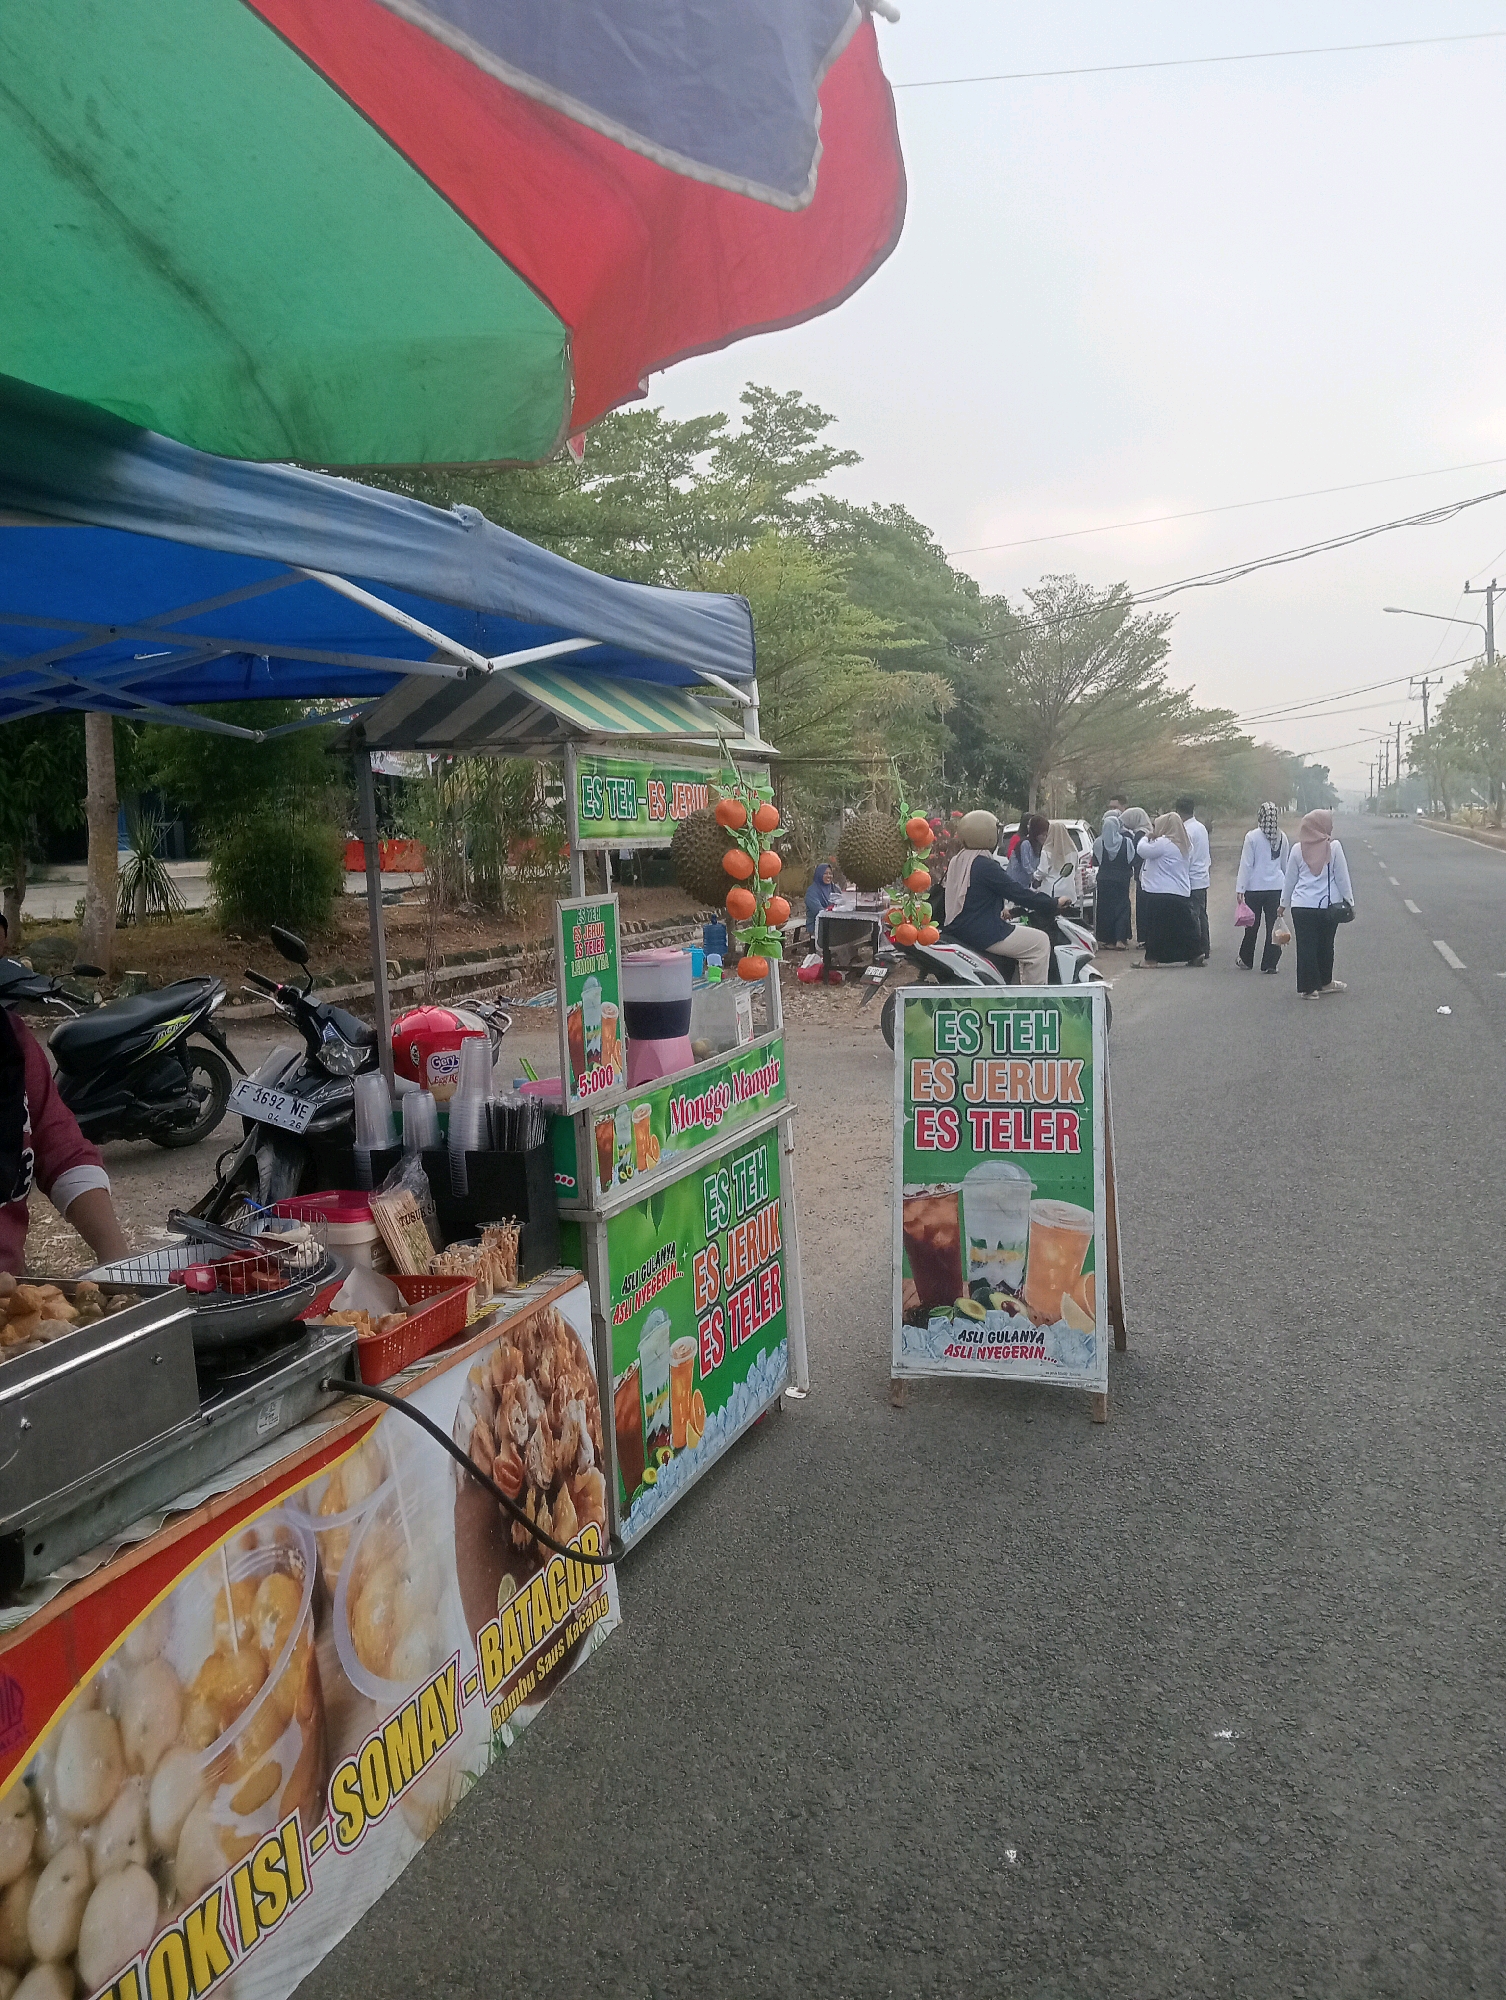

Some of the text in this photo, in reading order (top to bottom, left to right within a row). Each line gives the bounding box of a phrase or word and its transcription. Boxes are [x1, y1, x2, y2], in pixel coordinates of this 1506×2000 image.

[582, 776, 603, 819] ES
[573, 922, 605, 942] ES JERUK
[577, 906, 600, 925] ES TEH
[571, 953, 609, 977] LEMON TEA
[574, 938, 605, 959] ES TELER
[935, 1010, 1060, 1054] ES TEH
[431, 1054, 459, 1074] Gery
[448, 1074, 458, 1083] Ro
[579, 1064, 614, 1098] 5.000
[911, 1058, 1085, 1104] ES JERUK
[237, 1084, 250, 1097] F
[252, 1088, 286, 1111] 3692
[290, 1097, 309, 1120] NE
[670, 1056, 780, 1135] Monggo Mampir
[914, 1107, 1082, 1153] ES TELER
[704, 1145, 770, 1238] ES TEH
[398, 1206, 427, 1227] TUSUK
[621, 1240, 676, 1296] ASLI GULANYA
[692, 1198, 782, 1316] ES JERUK
[612, 1296, 633, 1326] ASLI
[698, 1261, 783, 1380] ES TELER
[943, 1343, 973, 1359] ASLI
[958, 1329, 1045, 1345] ASLI GULANYA
[490, 1592, 610, 1733] Bumbu Saus Kacang
[231, 1814, 307, 1953] ISI
[330, 1660, 459, 1847] SOMAY
